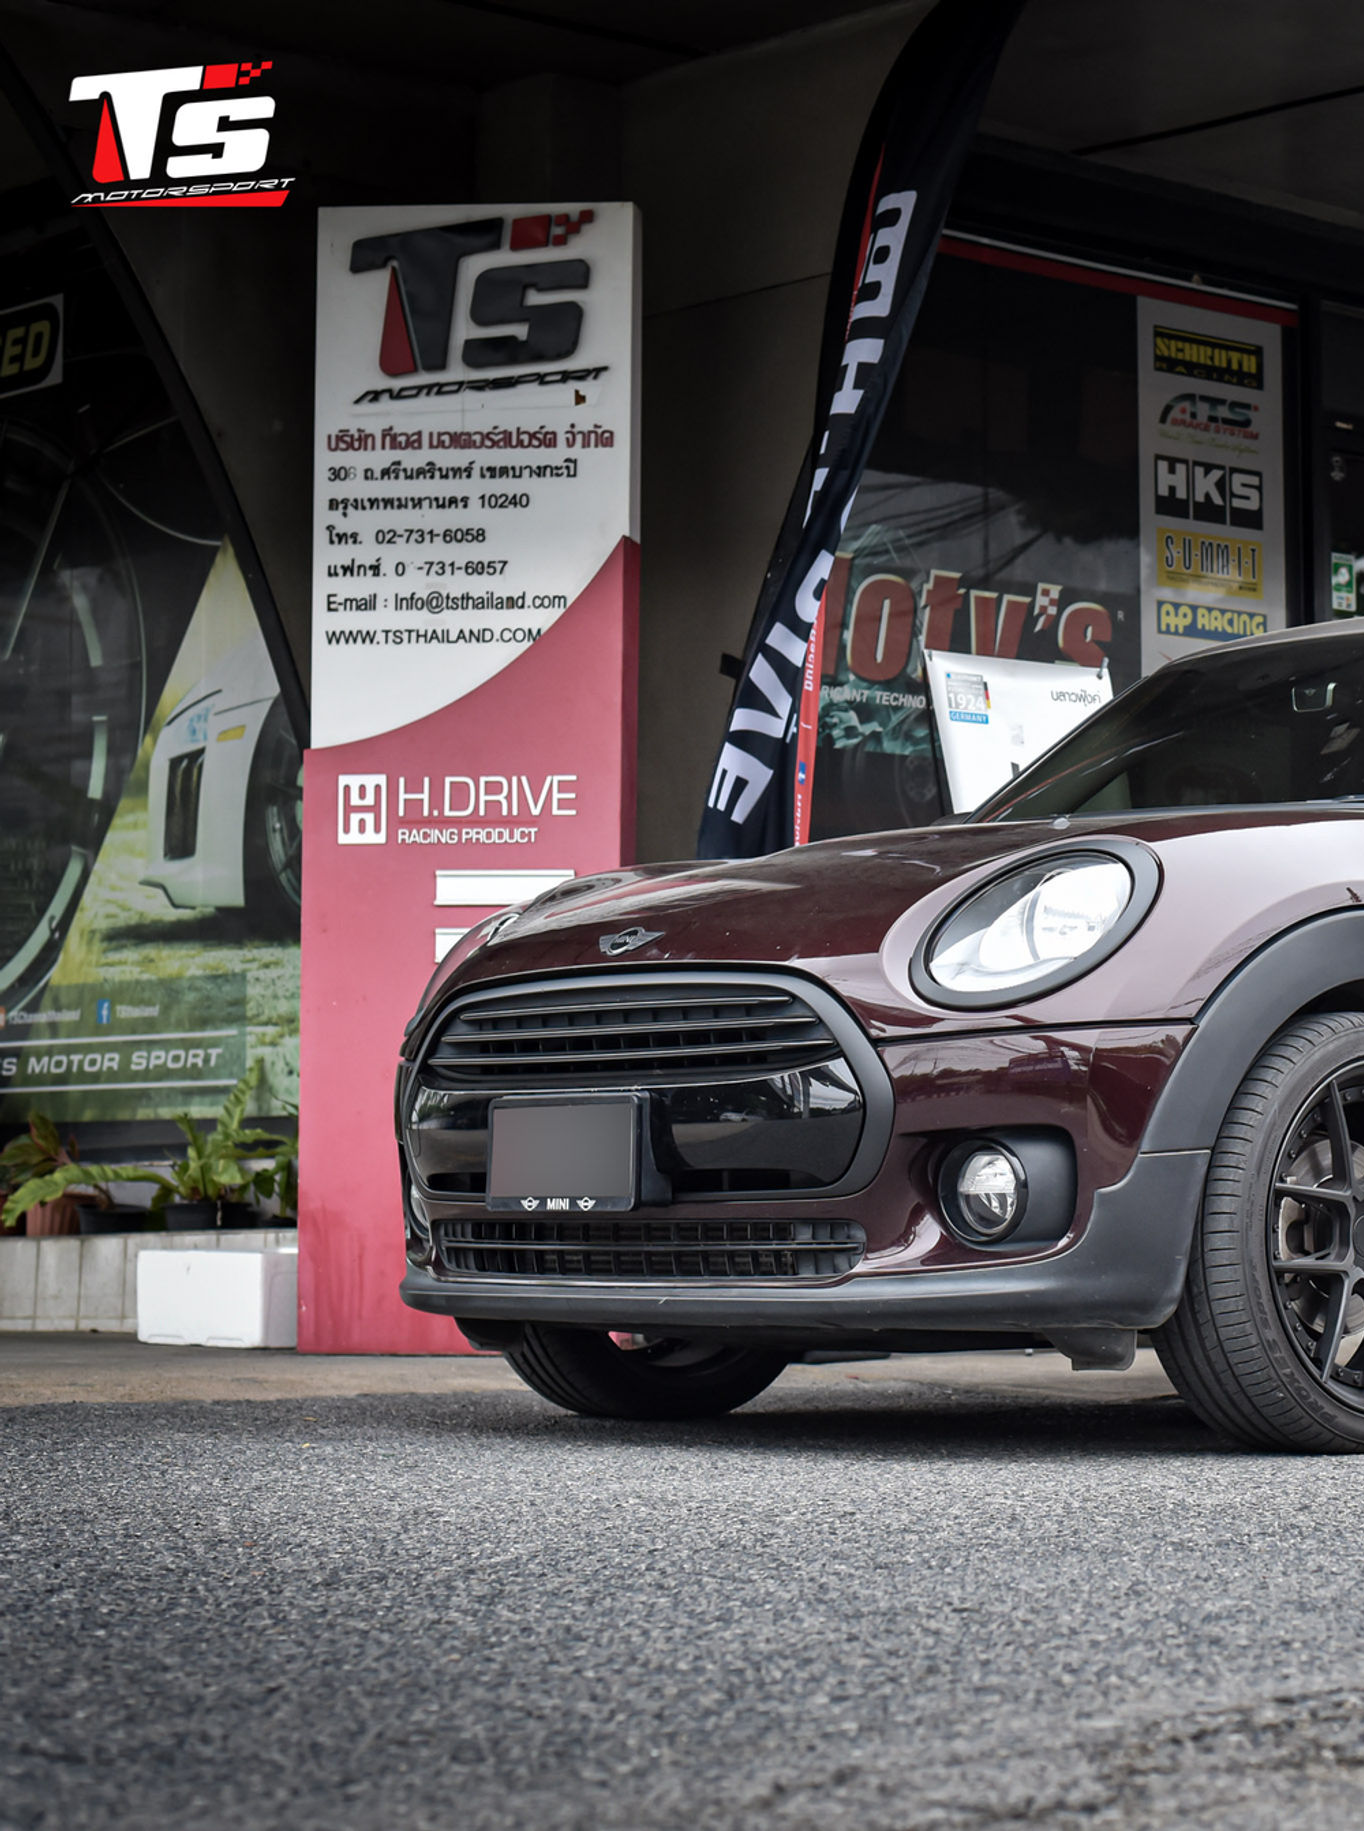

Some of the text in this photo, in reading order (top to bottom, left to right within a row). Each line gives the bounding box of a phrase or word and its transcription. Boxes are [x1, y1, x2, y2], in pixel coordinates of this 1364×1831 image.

[350, 216, 590, 376] TS
[0, 320, 51, 378] ED
[1155, 336, 1257, 374] SCHROTH
[353, 365, 609, 405] MOTORSPORT
[1159, 393, 1252, 428] ATS
[327, 428, 376, 452] บริษัท
[565, 423, 615, 449] จำกัด
[1170, 416, 1260, 440] BRAKE SYSTEM
[363, 461, 475, 481] ถ.ศรีนครินทร์
[1157, 459, 1260, 511] HKS
[328, 493, 530, 517] กรุงเทพมหานคร 10240
[326, 525, 486, 545] โทร. 02-731-6058
[395, 560, 508, 577] 0-731-6057
[327, 593, 377, 612] E-mail
[395, 591, 568, 614] Info@tsthailand.com
[1160, 602, 1265, 636] AP RACING
[325, 628, 542, 645] WWW.TSTHAILAND.COM
[949, 692, 984, 710] 1924
[951, 712, 987, 723] GERMANY
[398, 774, 577, 817] H.DRIVE
[398, 827, 539, 844] RACING PRODUCT
[0, 1049, 223, 1077] S MOTOR SPORT
[546, 1198, 570, 1211] MINI
